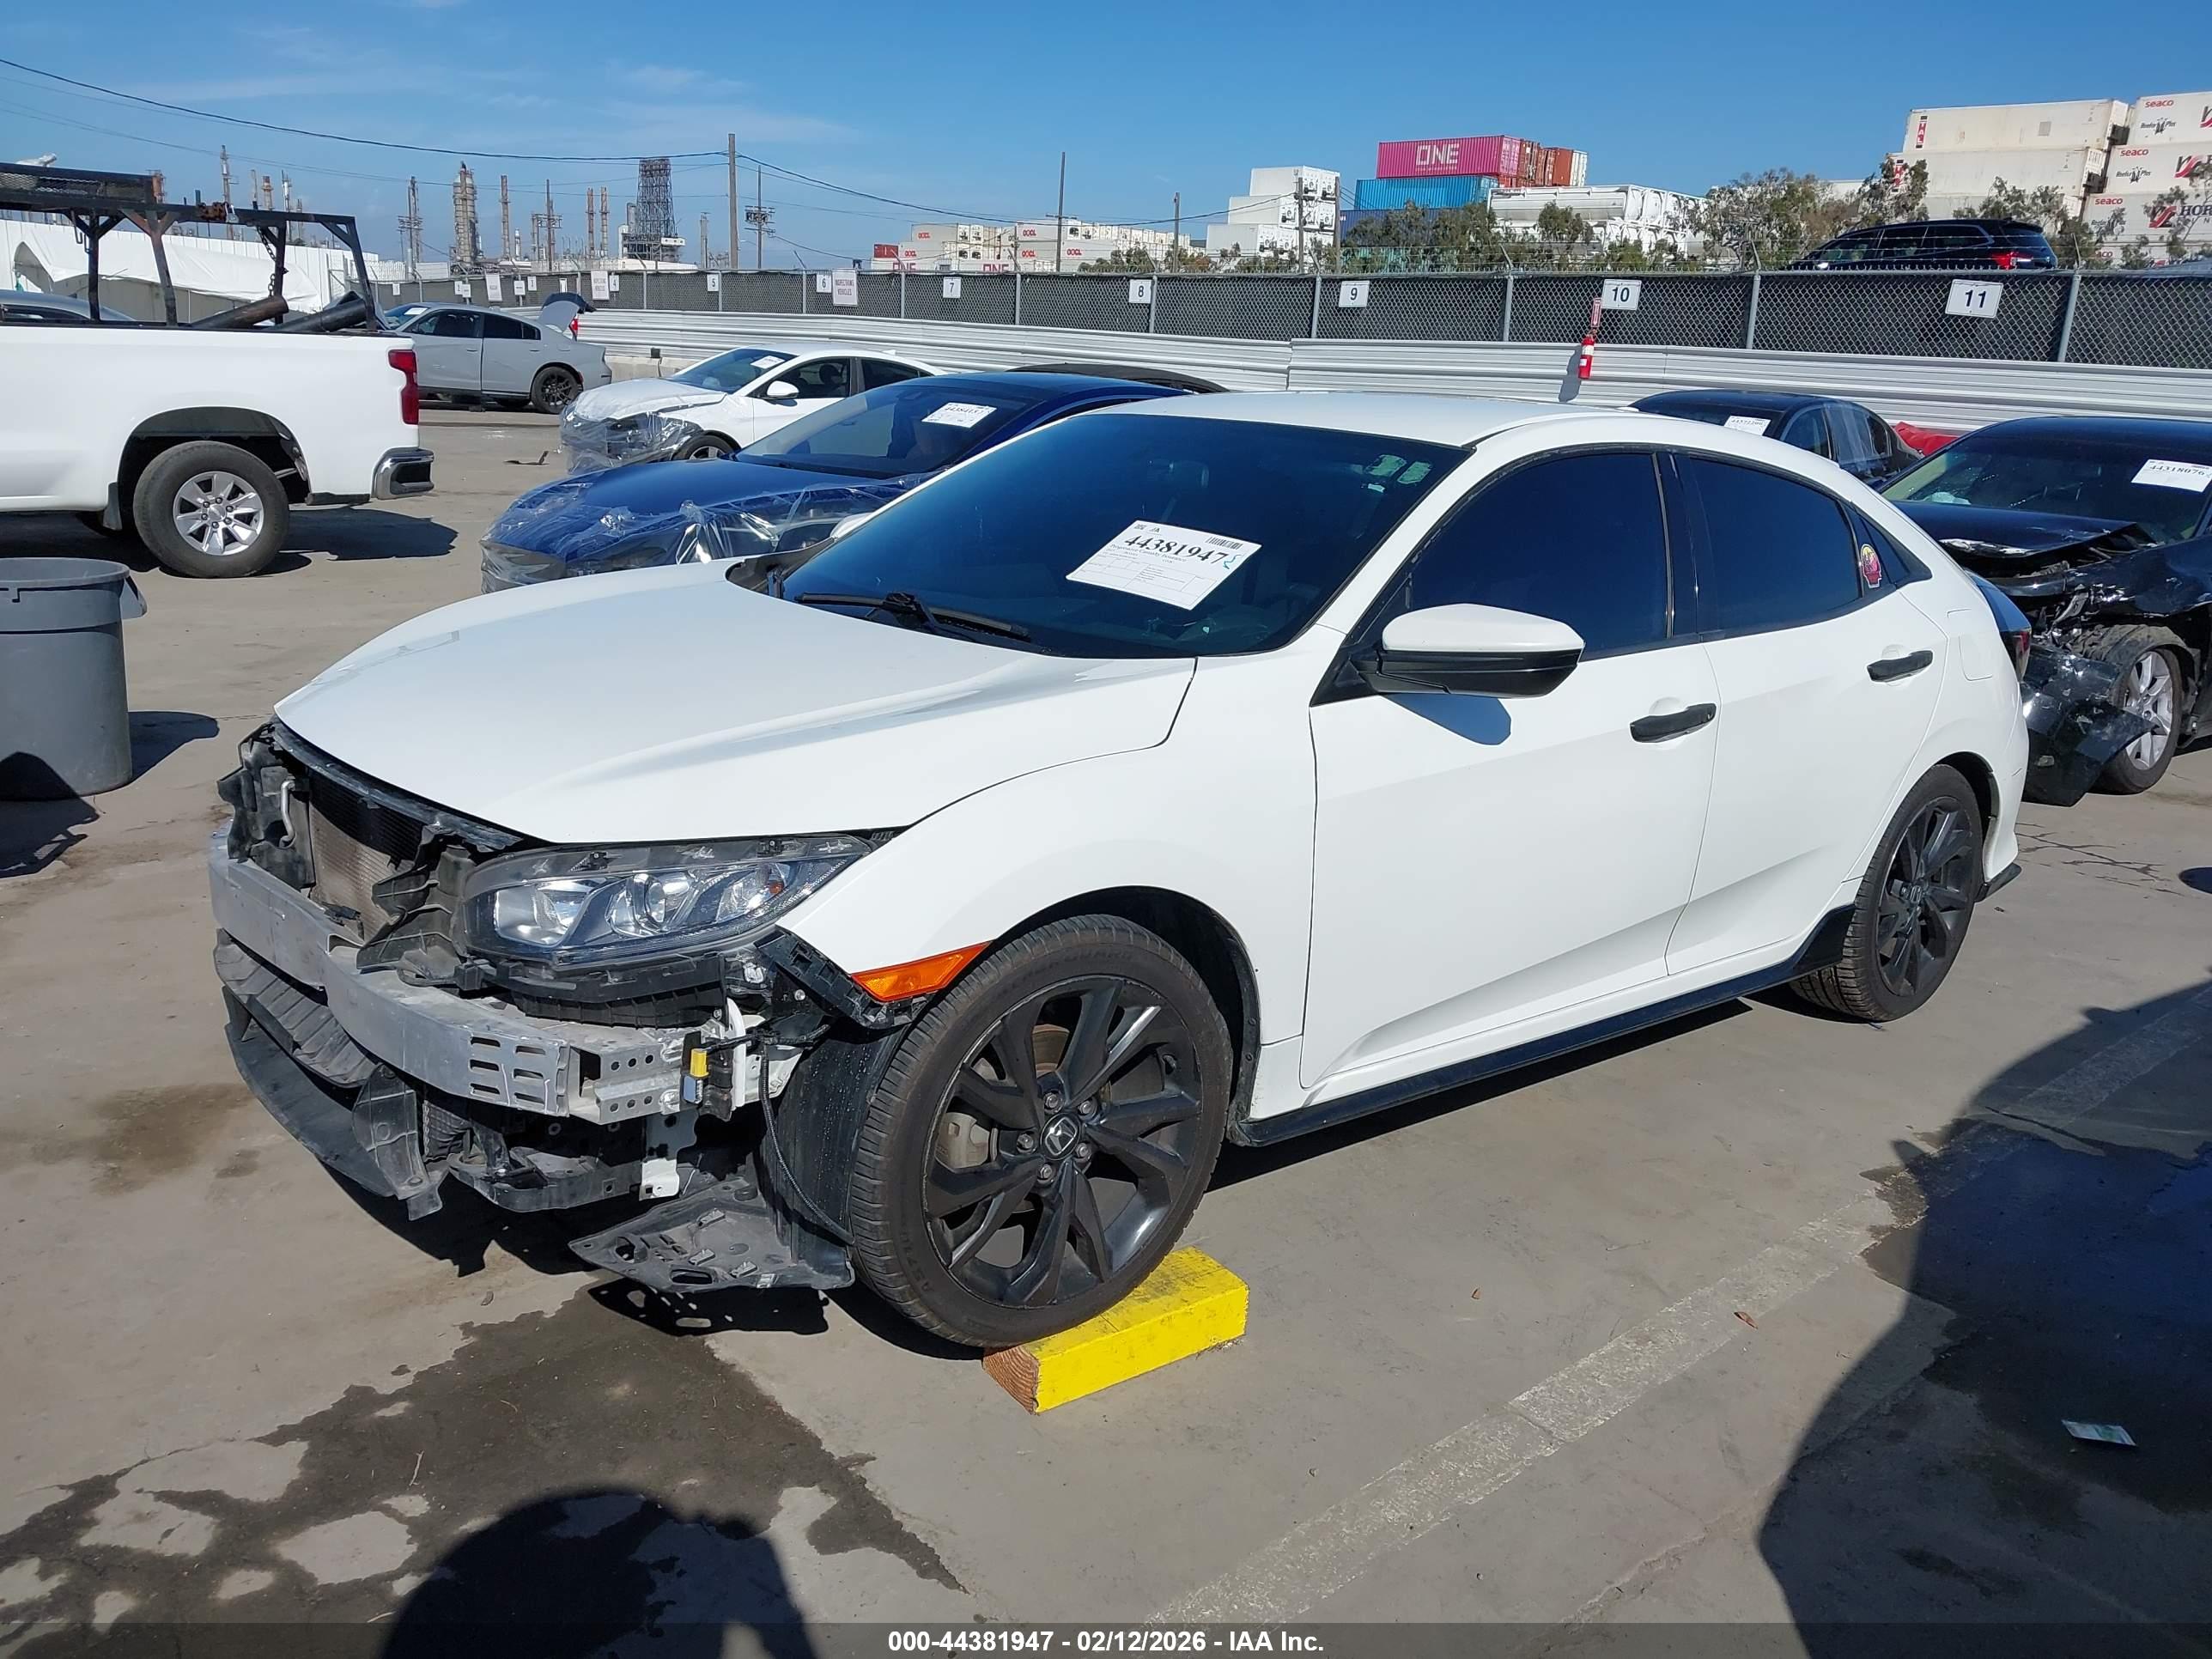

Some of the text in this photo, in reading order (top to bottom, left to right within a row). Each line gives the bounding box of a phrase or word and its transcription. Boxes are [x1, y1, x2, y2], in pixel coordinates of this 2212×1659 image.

[2144, 100, 2174, 108] seaco
[1415, 143, 1460, 166] ONE
[2119, 149, 2149, 157] seaco
[711, 277, 716, 288] 5
[822, 277, 826, 289] 6
[950, 283, 955, 294] 7
[1138, 285, 1144, 297] 8
[1350, 287, 1358, 301] 9
[1612, 287, 1630, 302] 10
[1965, 289, 1986, 308] 11
[1124, 535, 1230, 564] 44381947
